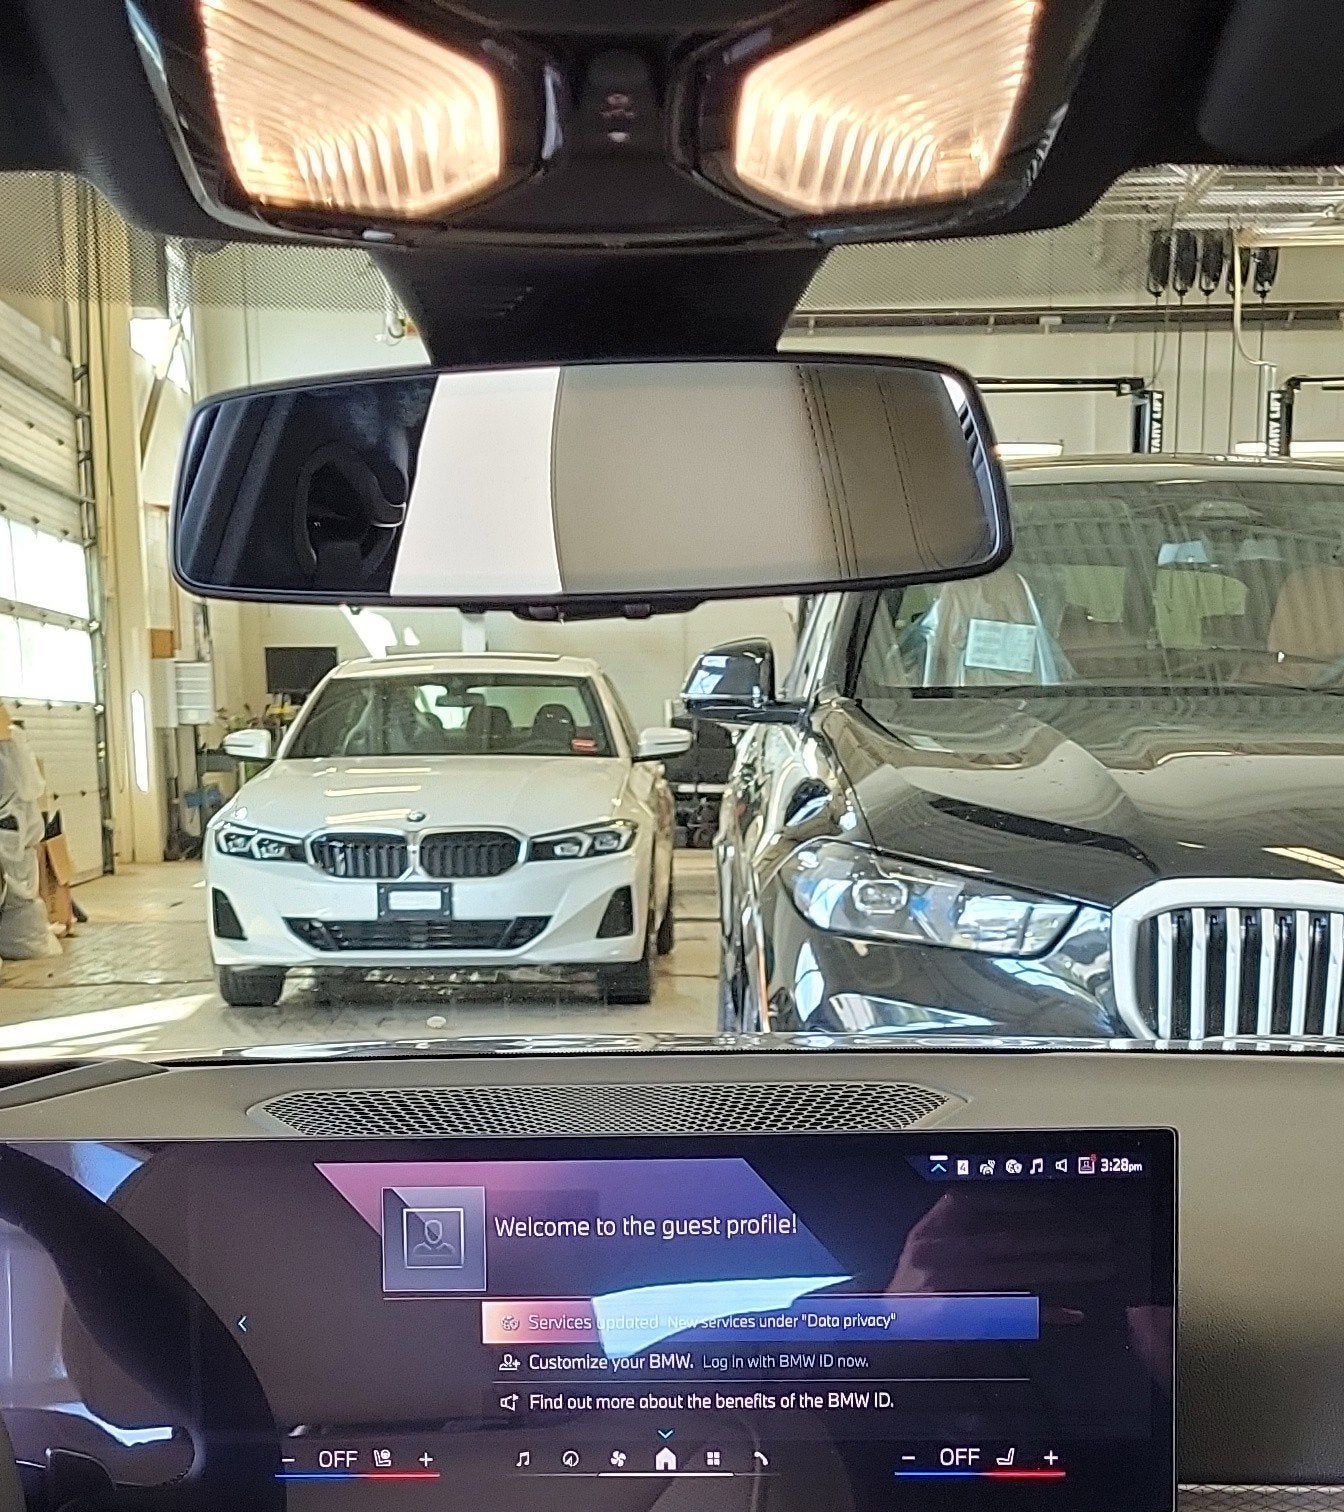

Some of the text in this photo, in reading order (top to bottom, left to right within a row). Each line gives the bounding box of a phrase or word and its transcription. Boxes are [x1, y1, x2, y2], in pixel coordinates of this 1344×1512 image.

[1100, 1157, 1143, 1173] 3:28pm
[494, 1213, 798, 1239] Welcome to the guest profile!
[528, 1314, 592, 1330] Services
[597, 1314, 659, 1332] updated
[701, 1314, 756, 1329] services
[759, 1313, 798, 1328] under
[801, 1313, 840, 1328] "Data
[843, 1312, 896, 1330] privacy"
[529, 1353, 694, 1373] Customize your BMW.
[702, 1354, 869, 1371] Log in with BMW ID now.
[529, 1392, 894, 1410] Find out more about the benefits of the BMW ID.
[319, 1450, 359, 1468] OFF
[940, 1447, 981, 1466] OFF
